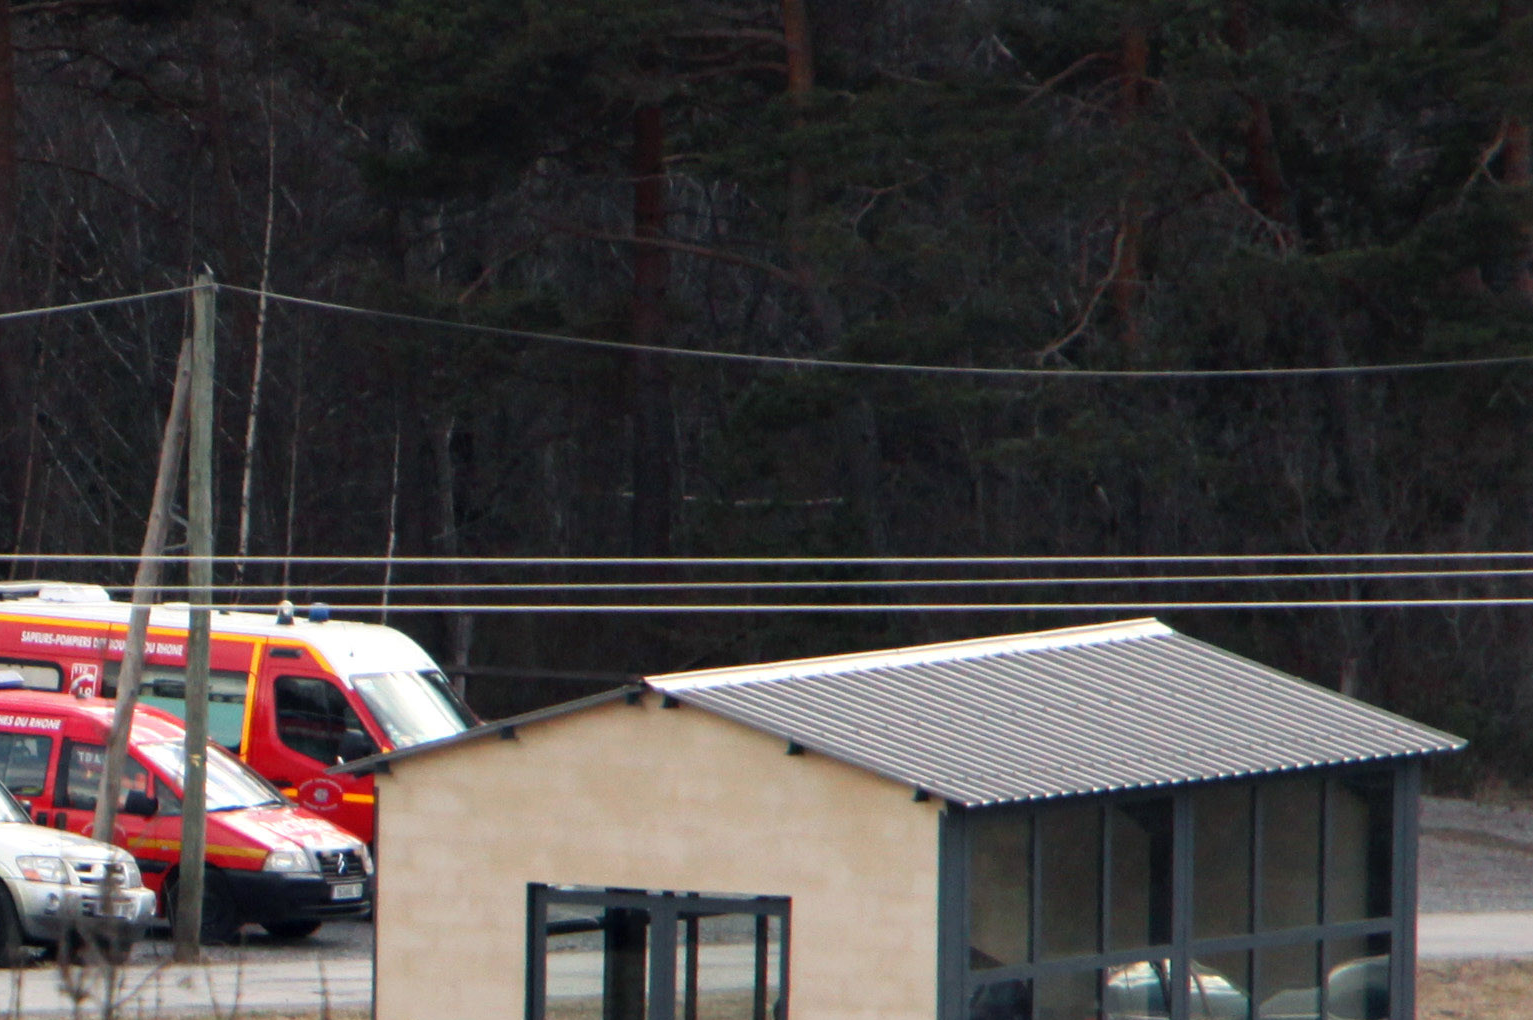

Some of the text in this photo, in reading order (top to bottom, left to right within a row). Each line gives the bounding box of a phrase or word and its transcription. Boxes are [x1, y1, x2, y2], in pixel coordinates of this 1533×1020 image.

[21, 630, 92, 649] SAPEURS-POMPIERS
[156, 643, 184, 657] RHONE
[13, 716, 27, 727] DU
[27, 717, 62, 730] RHONE
